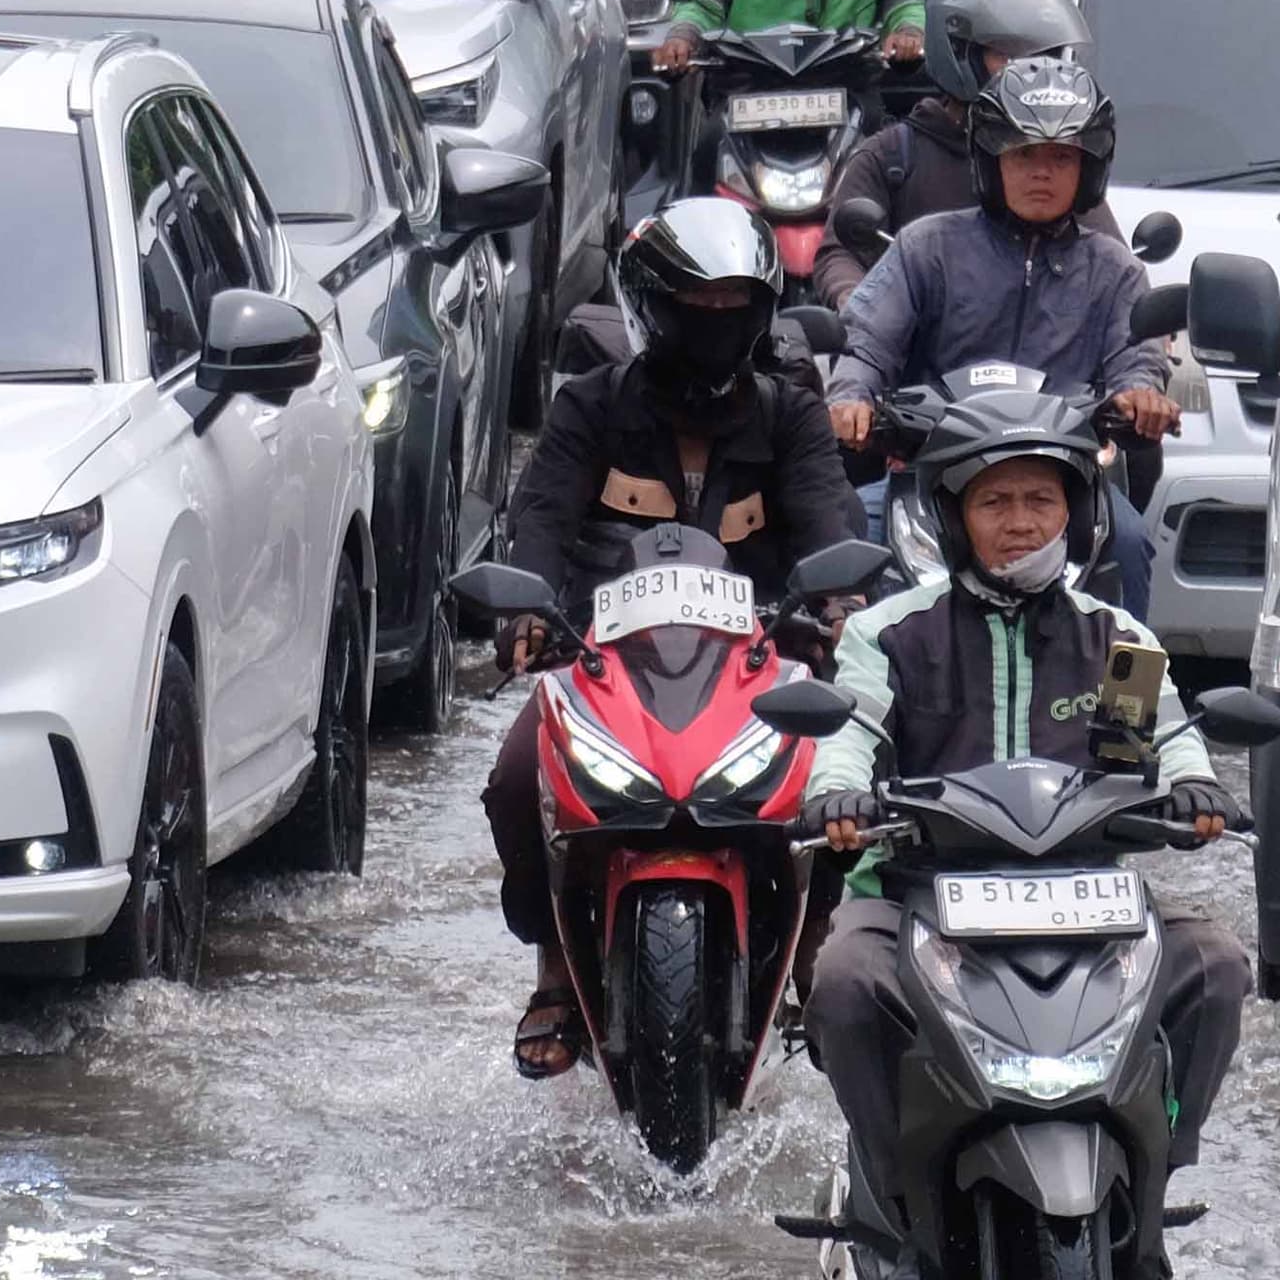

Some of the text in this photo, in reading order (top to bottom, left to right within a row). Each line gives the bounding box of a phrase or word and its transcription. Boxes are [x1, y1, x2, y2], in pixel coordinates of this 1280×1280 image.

[599, 570, 747, 612] B 6831 WTU
[948, 876, 1132, 903] B 5121 BLH
